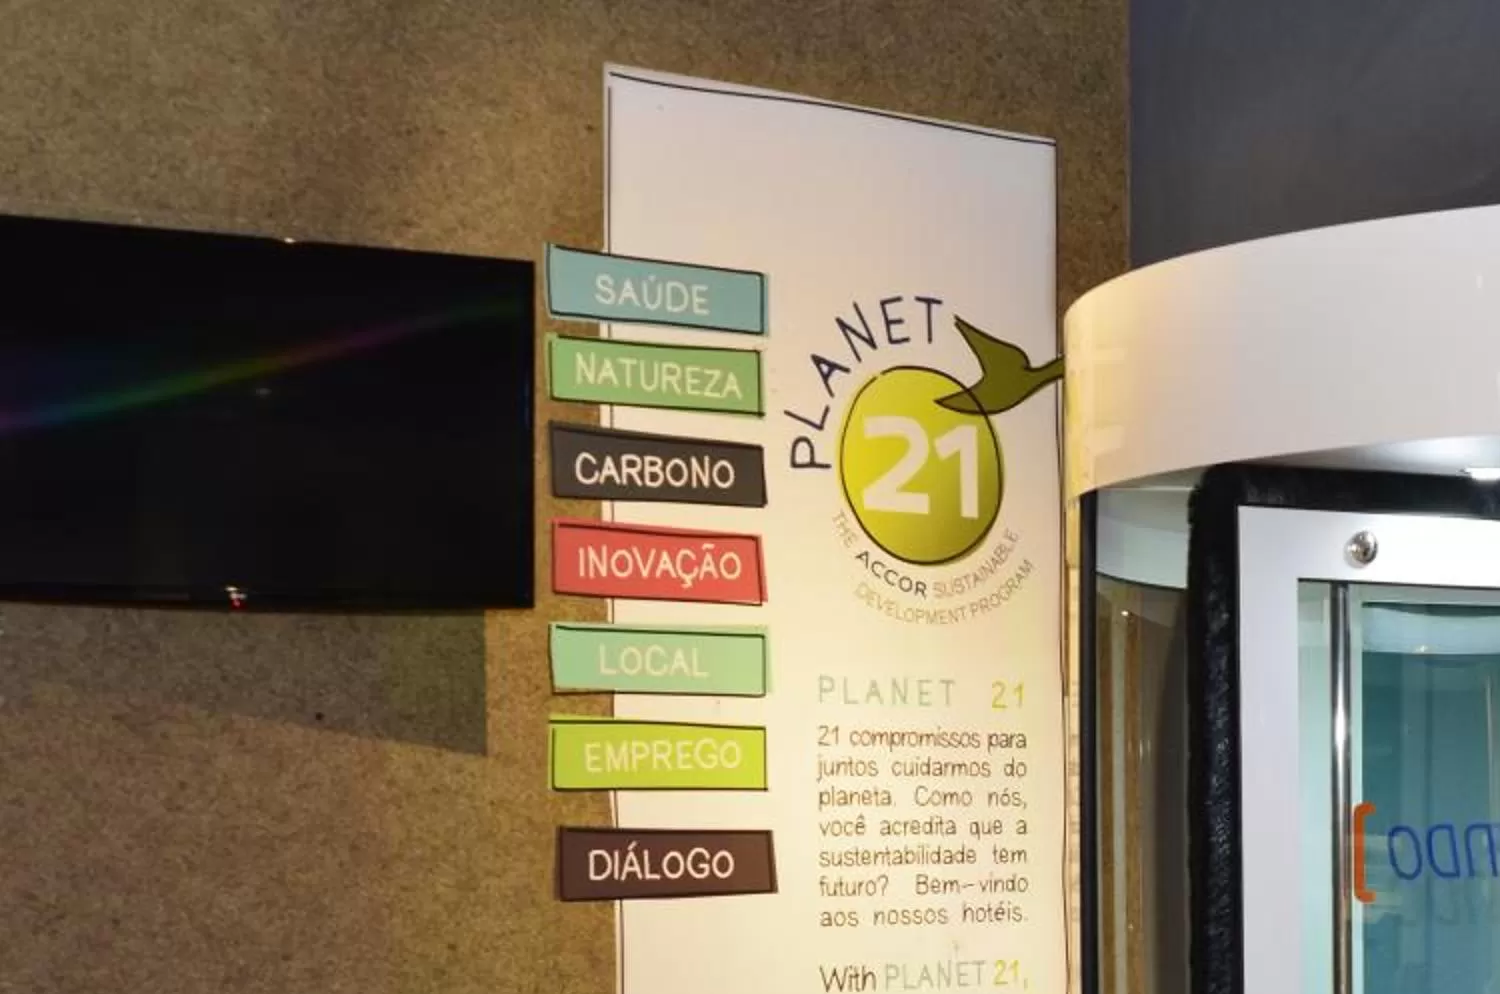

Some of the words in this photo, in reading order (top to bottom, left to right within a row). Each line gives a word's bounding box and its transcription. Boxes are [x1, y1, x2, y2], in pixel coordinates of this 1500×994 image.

[594, 273, 710, 315] SAÚDE
[575, 352, 743, 399] NATUREZA
[784, 296, 942, 468] PLANET
[575, 452, 735, 489] CARBONO
[863, 415, 979, 519] 21
[579, 544, 741, 588] INOVAÇÃO
[832, 509, 859, 548] THE
[856, 551, 927, 599] ACCOR
[932, 528, 1019, 599] SUSTAINABLE
[854, 582, 967, 625] DEVELOPMENT
[970, 559, 1033, 616] PROGRAM
[600, 644, 709, 677] LOCAL
[818, 675, 956, 706] PLANET
[991, 681, 1025, 709] 21
[584, 738, 742, 773] EMPREGO
[818, 726, 840, 746] 21
[850, 727, 980, 751] compromissos
[988, 732, 1026, 753] para
[817, 756, 878, 782] juntos
[892, 757, 991, 777] cuidarmos
[1004, 757, 1026, 777] do
[818, 787, 896, 811] planeta.
[915, 786, 972, 807] Como
[988, 789, 1027, 809] nós,
[819, 814, 866, 837] você
[880, 817, 957, 836] acredita
[969, 820, 1003, 840] que
[1016, 821, 1027, 835] a
[588, 841, 735, 882] DIÁLOGO
[818, 845, 976, 867] sustentabilidade
[993, 847, 1027, 864] tem
[818, 875, 889, 897] futuro?
[915, 874, 1028, 894] Bem-vindo
[821, 909, 858, 927] aos
[873, 907, 949, 925] nossos
[962, 901, 1027, 923] hotéis.
[819, 965, 877, 993] With
[885, 959, 986, 990] PLANET
